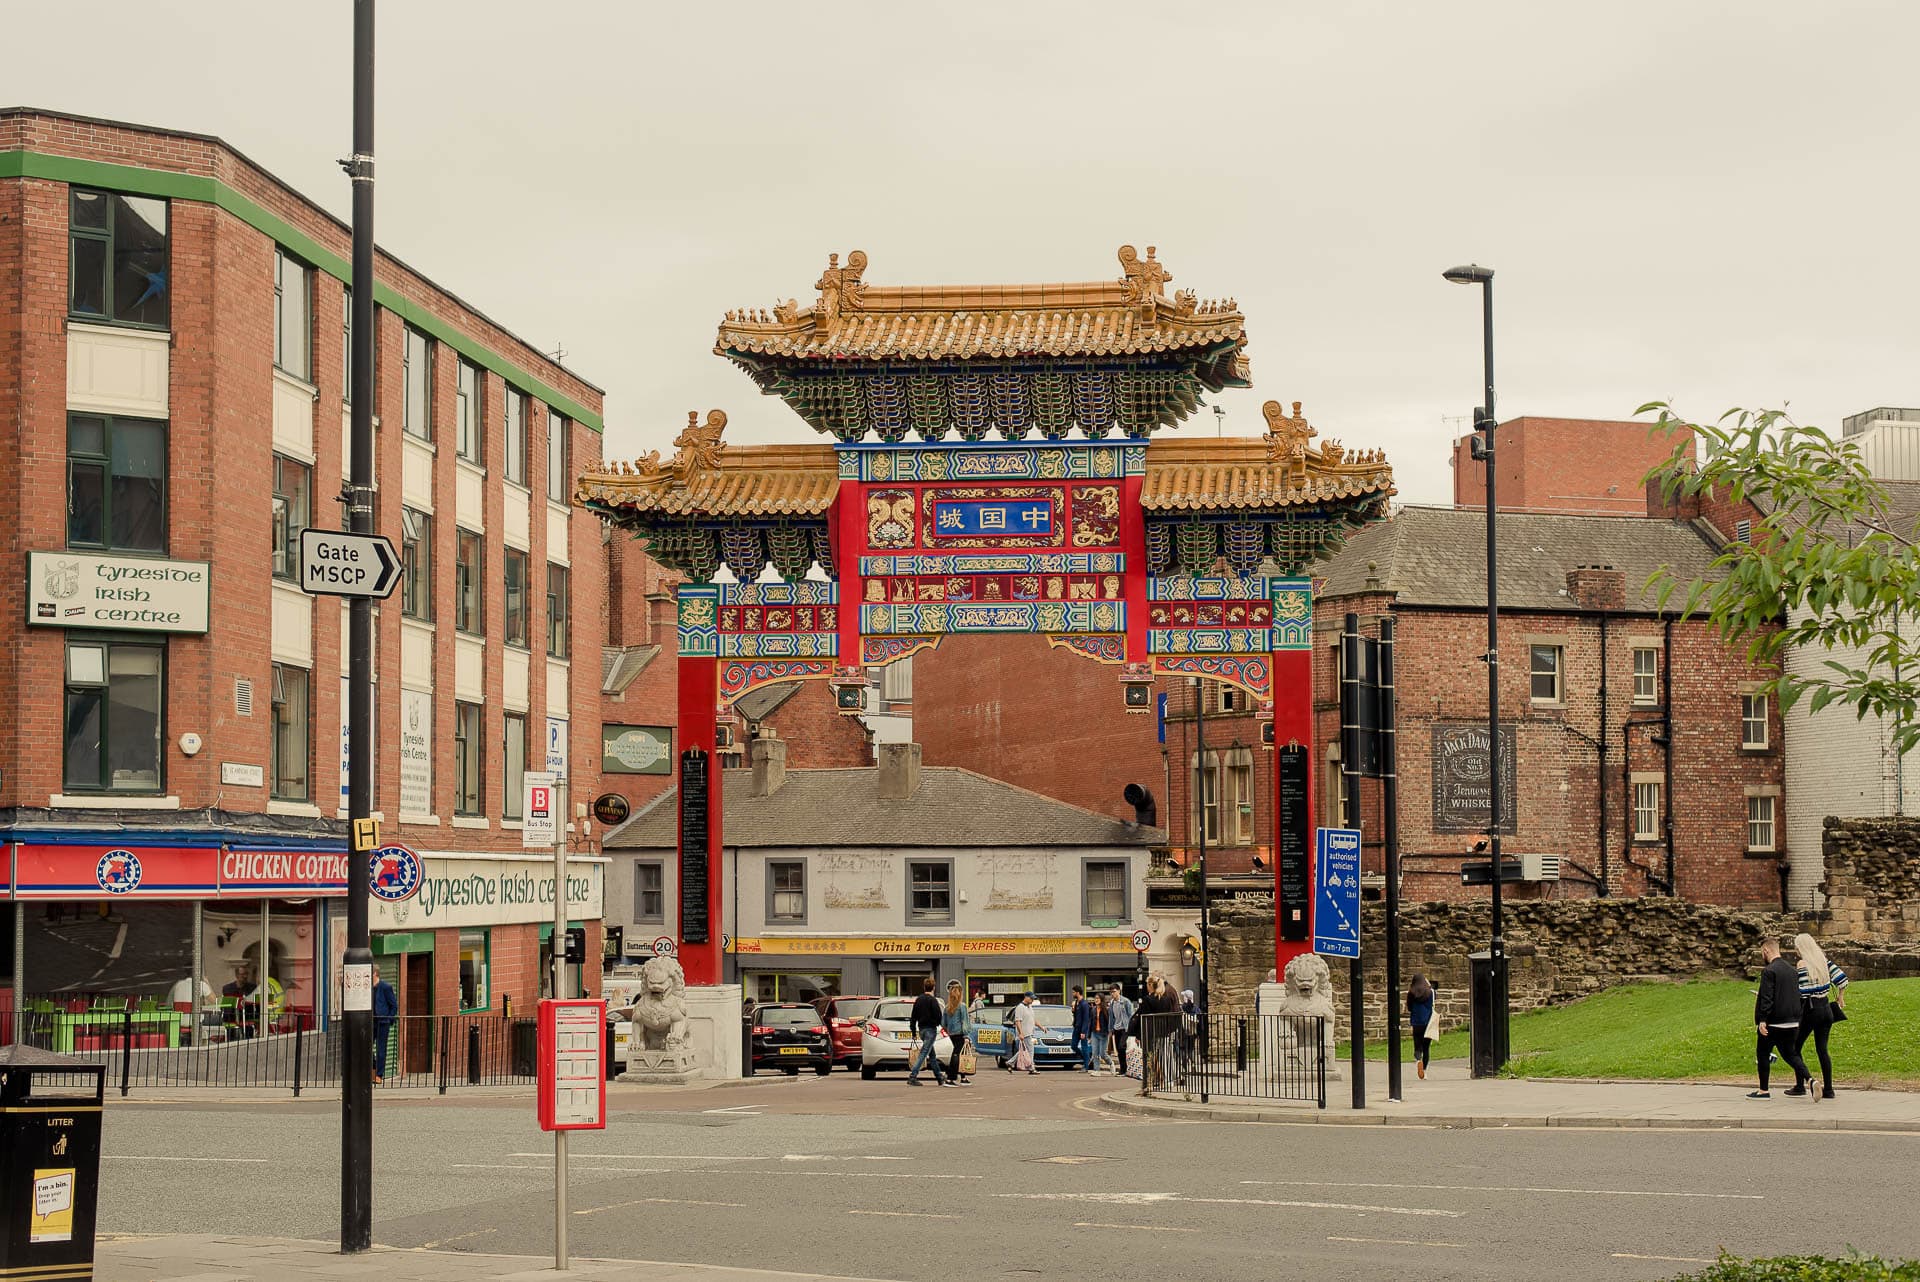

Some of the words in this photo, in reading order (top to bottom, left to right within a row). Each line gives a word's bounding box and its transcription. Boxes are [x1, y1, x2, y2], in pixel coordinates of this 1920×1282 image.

[317, 543, 359, 562] Gate
[95, 564, 201, 582] tyneside
[310, 564, 365, 585] MSCP
[403, 731, 424, 746] Tyneside
[551, 727, 558, 748] P
[1444, 737, 1467, 757] JACK
[401, 747, 411, 759] rish
[411, 748, 428, 761] Centre
[535, 789, 546, 808] B
[1451, 799, 1492, 808] WHISKE
[540, 820, 553, 829] Stop
[1329, 853, 1357, 861] authorised
[223, 853, 291, 880] CHICKEN
[296, 854, 349, 880] COTTAG
[1332, 862, 1354, 871] vehicles
[538, 873, 589, 903] cetre
[1346, 891, 1357, 899] taxi
[656, 942, 671, 952] 20
[874, 941, 911, 952] China
[916, 941, 951, 952] Town
[962, 942, 1017, 951] EXPRESS
[1134, 936, 1148, 946] 20
[47, 1118, 74, 1126] LITTER
